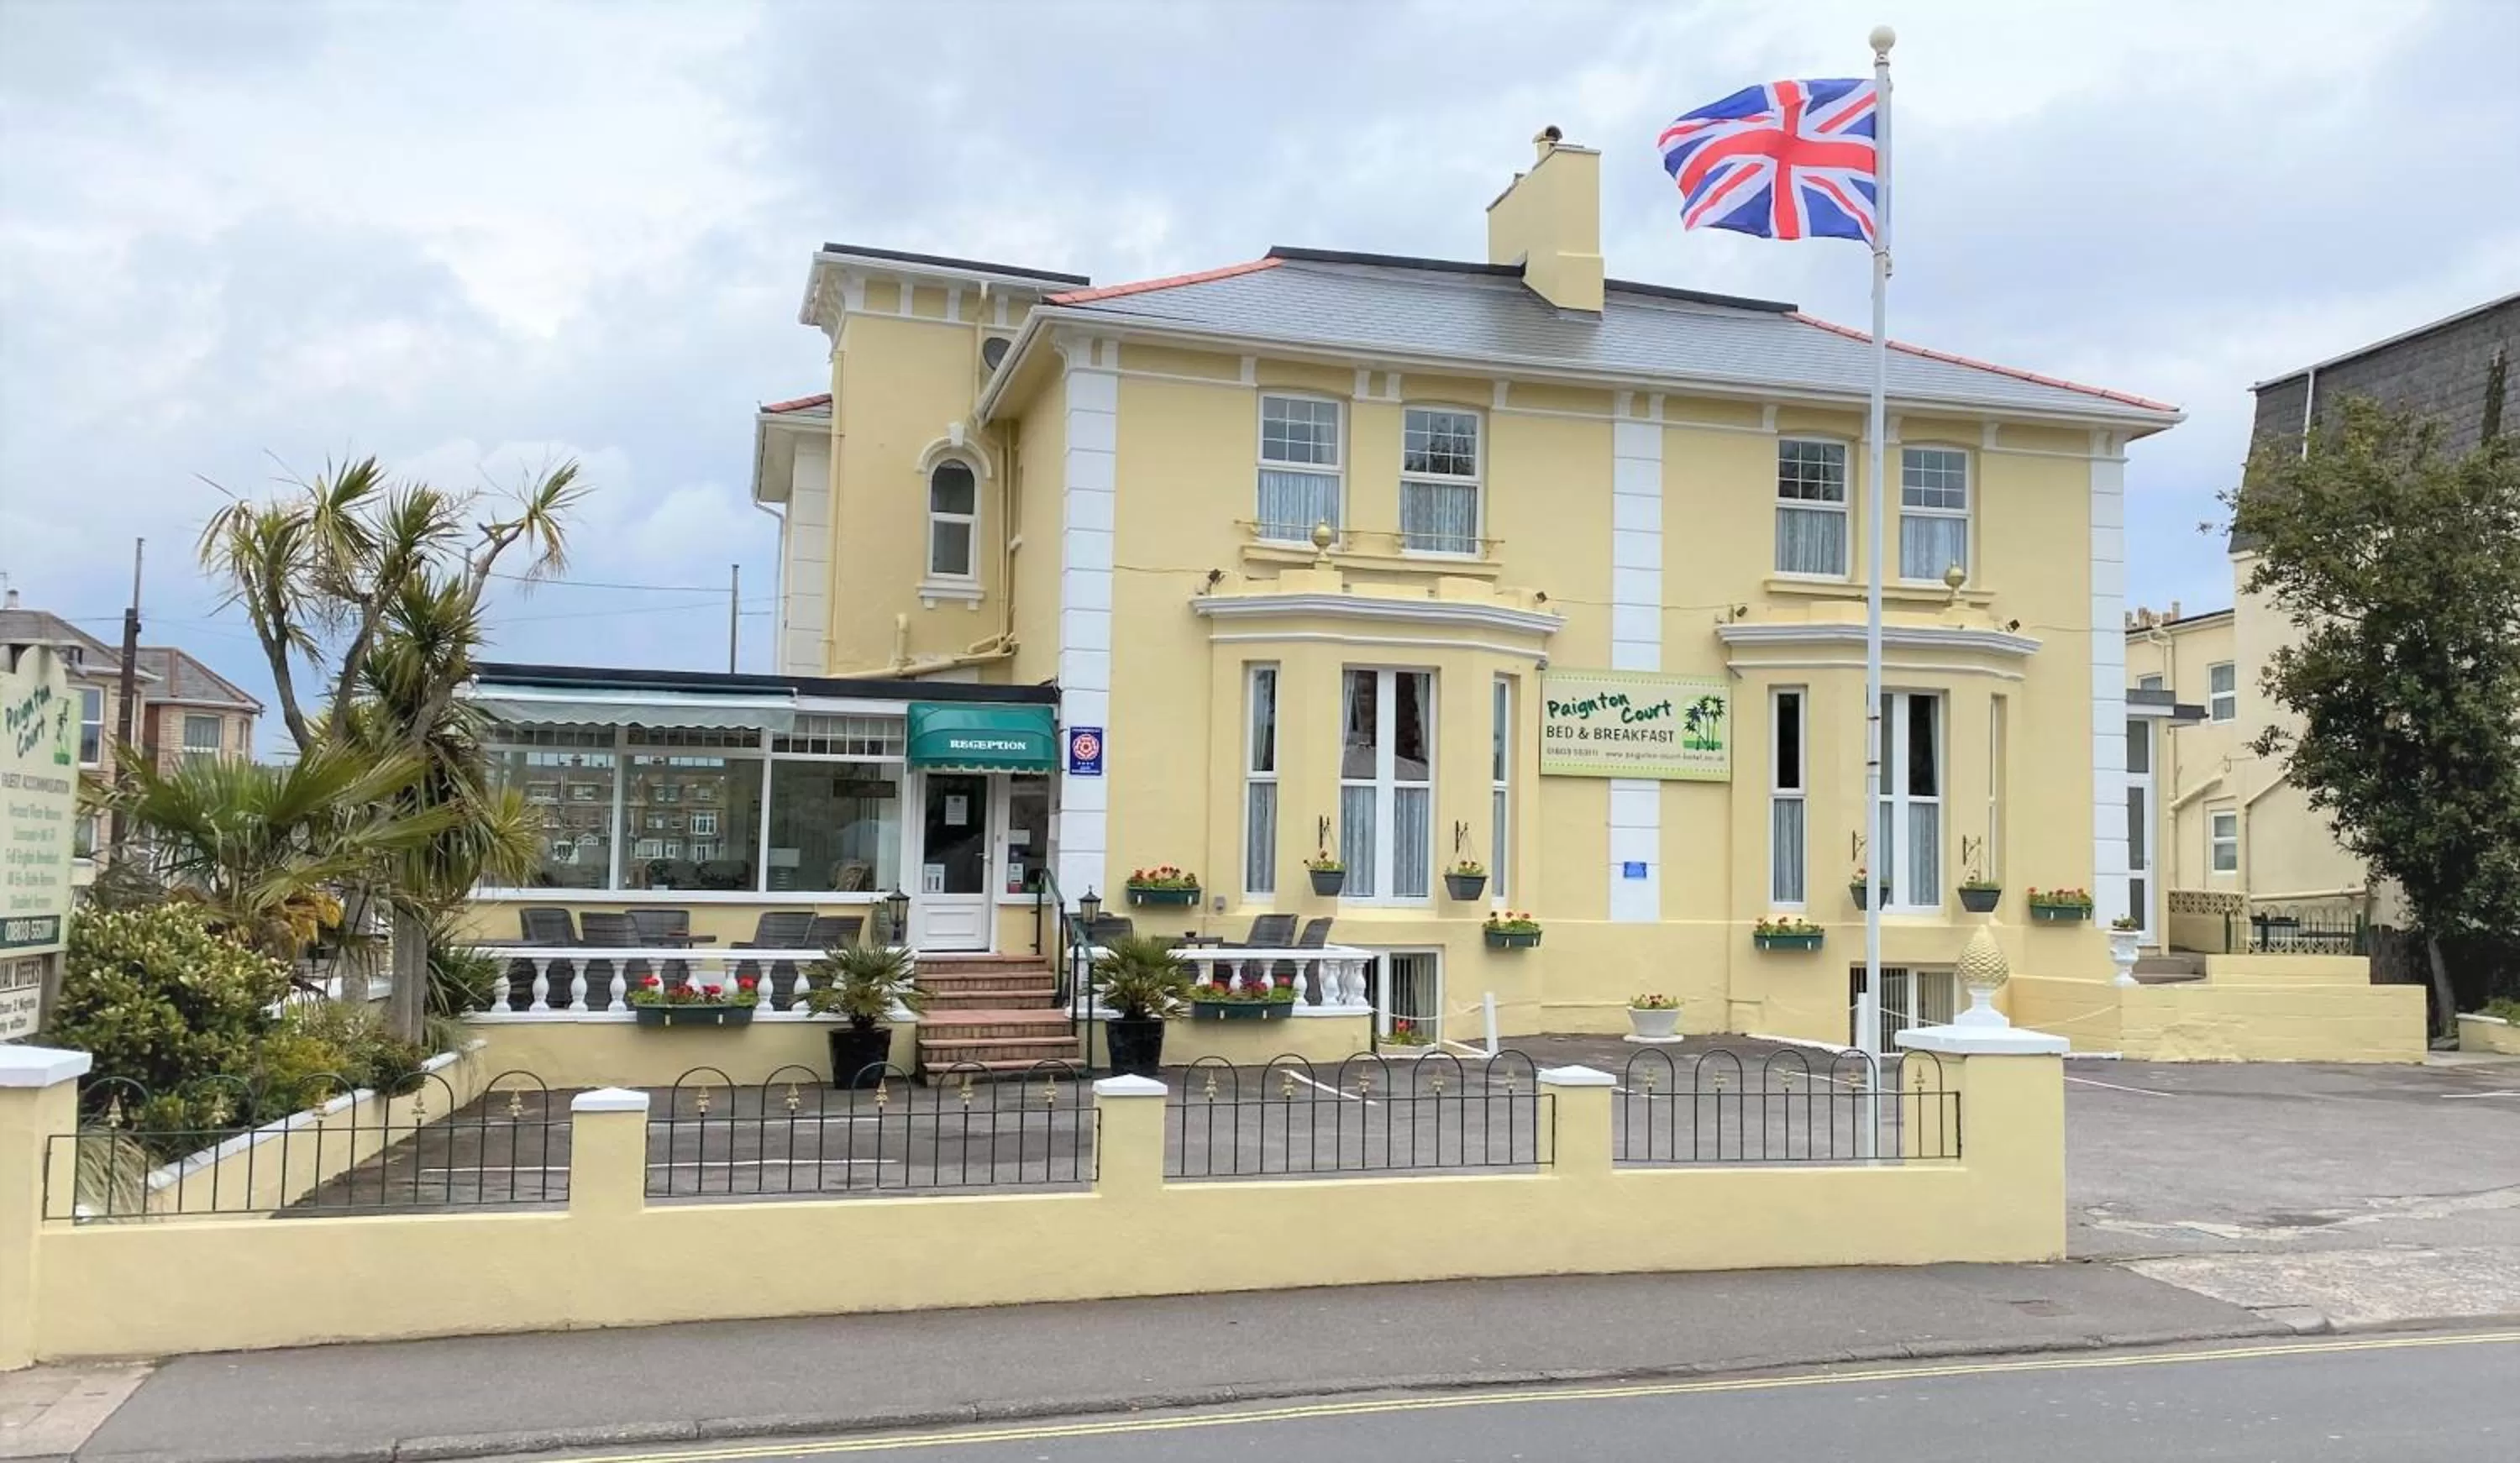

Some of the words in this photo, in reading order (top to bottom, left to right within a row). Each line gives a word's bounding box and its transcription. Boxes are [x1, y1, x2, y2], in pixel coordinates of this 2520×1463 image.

[5, 684, 51, 734] Paignton
[1547, 691, 1630, 720] Paignton
[1621, 700, 1672, 724] Court
[18, 714, 45, 758] Court
[949, 739, 1026, 750] RECEPTION
[1546, 725, 1573, 738] BED
[1578, 727, 1589, 740] &
[1593, 727, 1675, 743] BREAKFAST
[2, 772, 21, 788] GUEST
